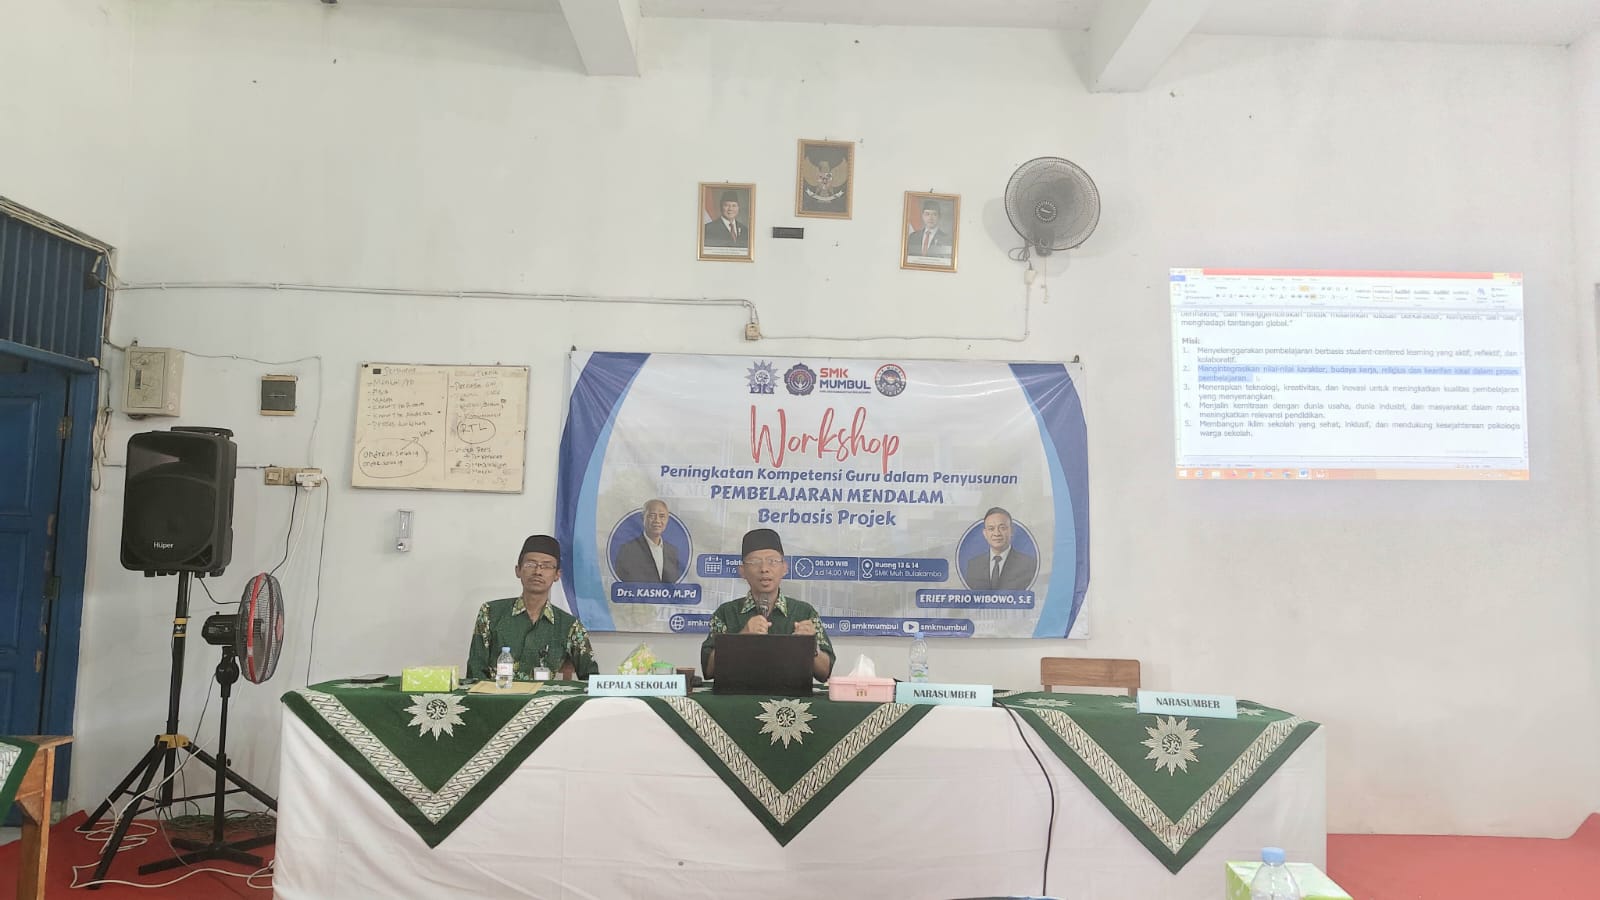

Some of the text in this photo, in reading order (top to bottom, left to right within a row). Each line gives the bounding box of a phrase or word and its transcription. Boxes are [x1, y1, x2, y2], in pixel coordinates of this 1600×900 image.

[820, 367, 849, 379] SMK
[819, 379, 871, 390] MUMBUL
[750, 404, 900, 475] Workshop
[660, 465, 1018, 487] Peningkatan Kompetensi Guru dalam Penyusunan
[710, 484, 945, 504] PEMBELAJARAN MENDALAM
[758, 508, 897, 528] Berbasis Projek
[874, 562, 897, 570] Ruang
[616, 588, 697, 599] Drs. KASNO, M.Pd
[920, 594, 1032, 605] ERIEF PRIO WIBOWO, S.E
[852, 622, 968, 631] smkmumbul smkmumbul
[596, 681, 678, 690] KEPALA SEKOLAH
[913, 689, 977, 700] NARASUMBER
[1156, 697, 1221, 709] NARASUMBER
